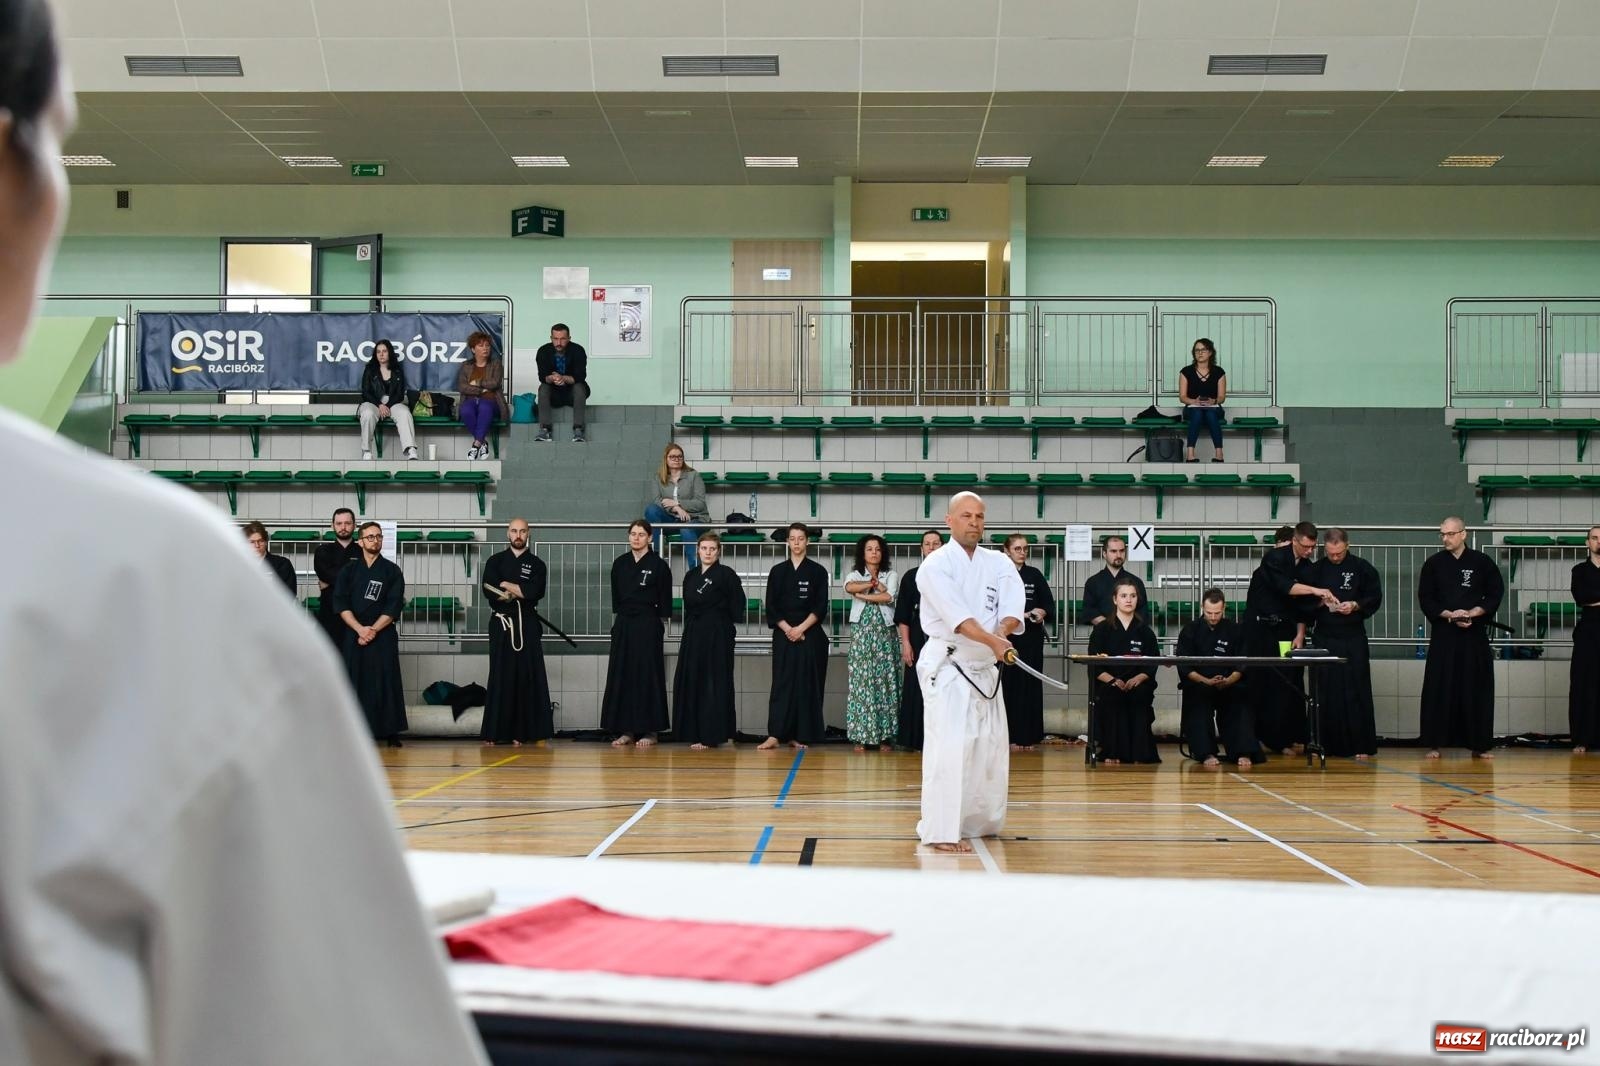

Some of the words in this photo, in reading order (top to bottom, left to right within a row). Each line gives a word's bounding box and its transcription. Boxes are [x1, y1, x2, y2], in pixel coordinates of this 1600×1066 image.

[517, 216, 528, 233] F
[542, 216, 557, 232] F
[171, 330, 265, 361] OSiR
[316, 334, 468, 363] RACBÓRZ
[208, 362, 265, 373] RACIBÓRZ
[1132, 527, 1152, 550] X
